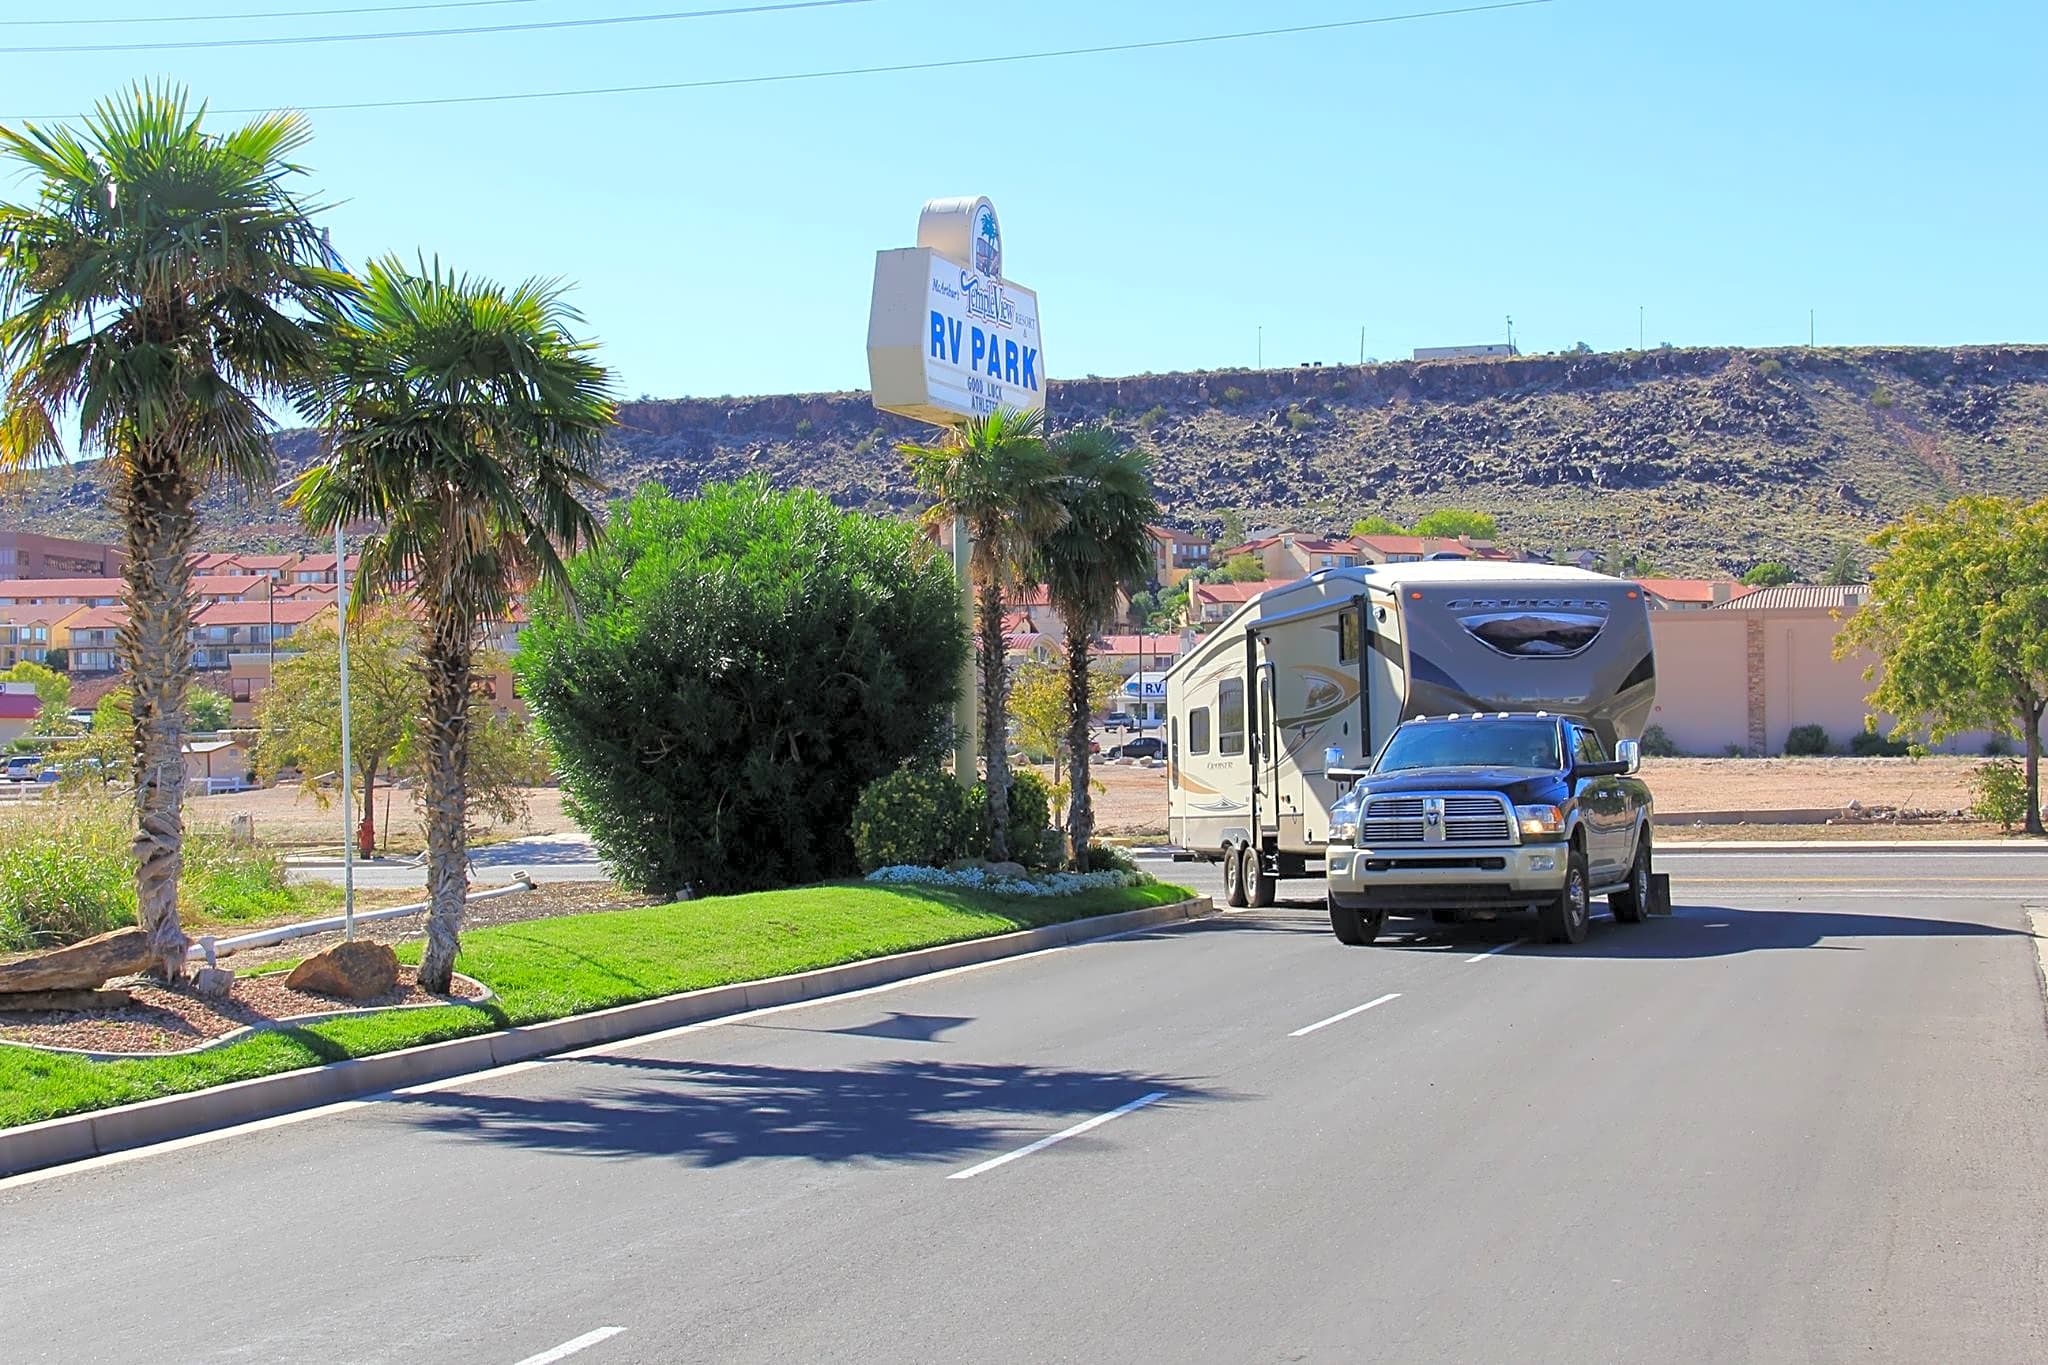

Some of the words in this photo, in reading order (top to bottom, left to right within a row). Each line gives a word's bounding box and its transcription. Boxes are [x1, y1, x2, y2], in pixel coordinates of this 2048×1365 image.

[930, 310, 962, 364] RV
[971, 326, 1038, 392] PARK
[967, 376, 984, 393] GOOD
[987, 383, 1003, 401] LUCK
[1145, 683, 1164, 694] R.V.
